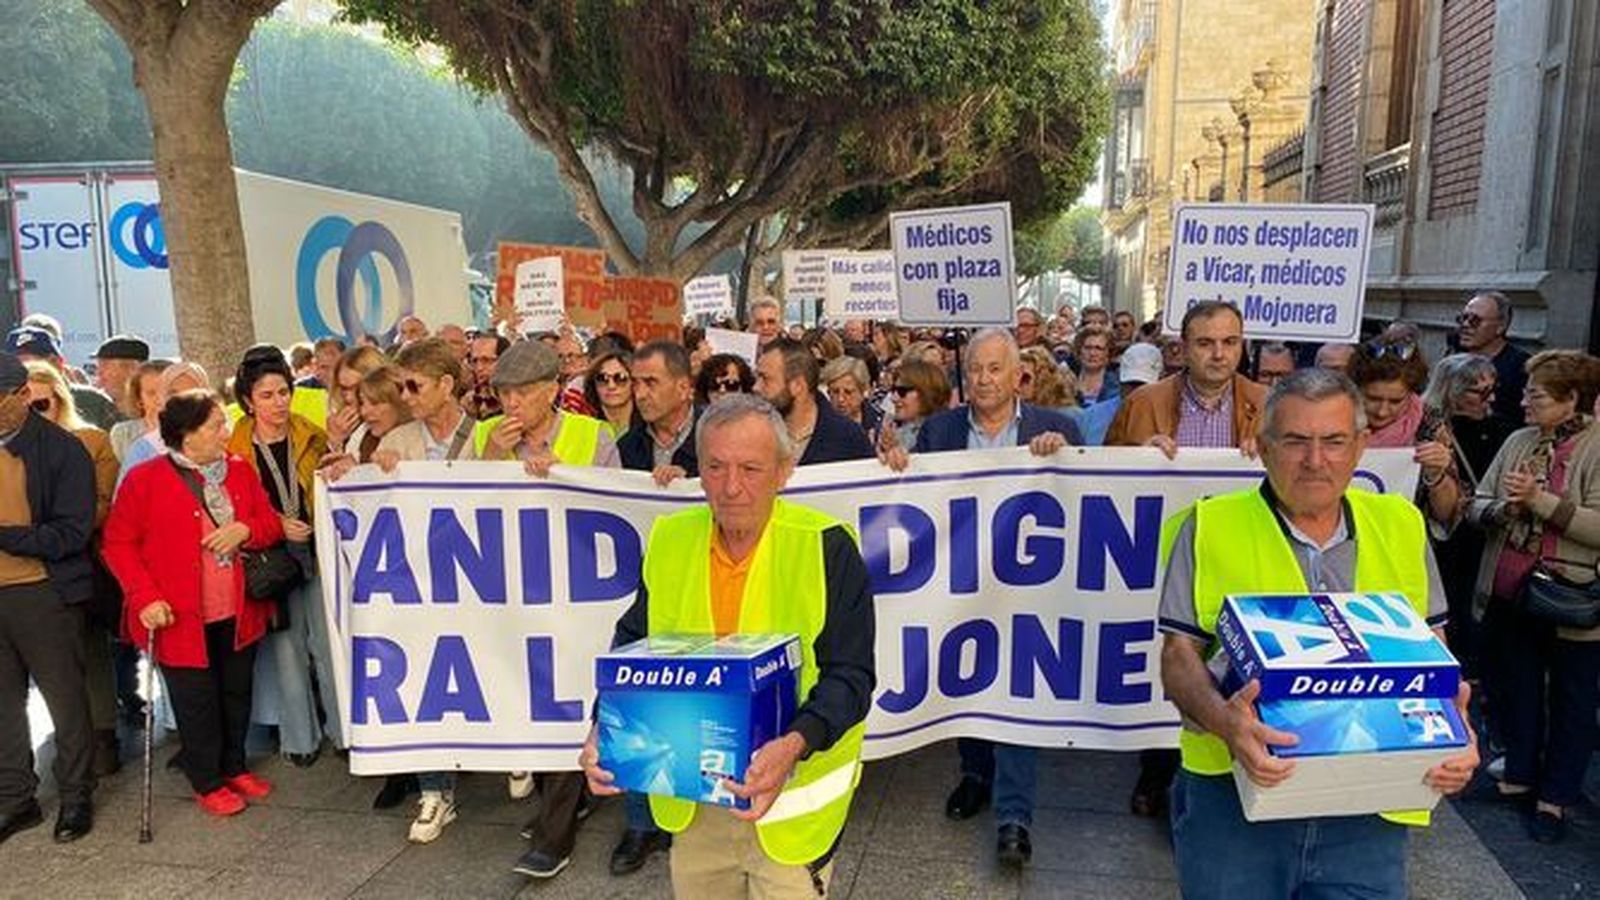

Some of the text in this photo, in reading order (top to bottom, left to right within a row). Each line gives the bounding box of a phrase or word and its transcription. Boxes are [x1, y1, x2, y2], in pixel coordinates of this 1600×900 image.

[906, 223, 992, 250] Médicos
[1182, 219, 1359, 253] No nos desplacen
[831, 260, 858, 275] Más
[861, 258, 895, 275] calid
[903, 256, 1001, 283] con plaza
[1185, 256, 1346, 288] a Vícar, médicos
[850, 279, 892, 293] menos
[844, 298, 897, 312] recortes
[937, 289, 970, 315] fija
[1243, 295, 1338, 327] Mojonera
[331, 490, 1166, 605] ANID DIGN
[1218, 610, 1246, 661] Double
[351, 613, 1160, 725] RA L JONE
[615, 665, 697, 686] Double
[1289, 674, 1395, 695] Double
